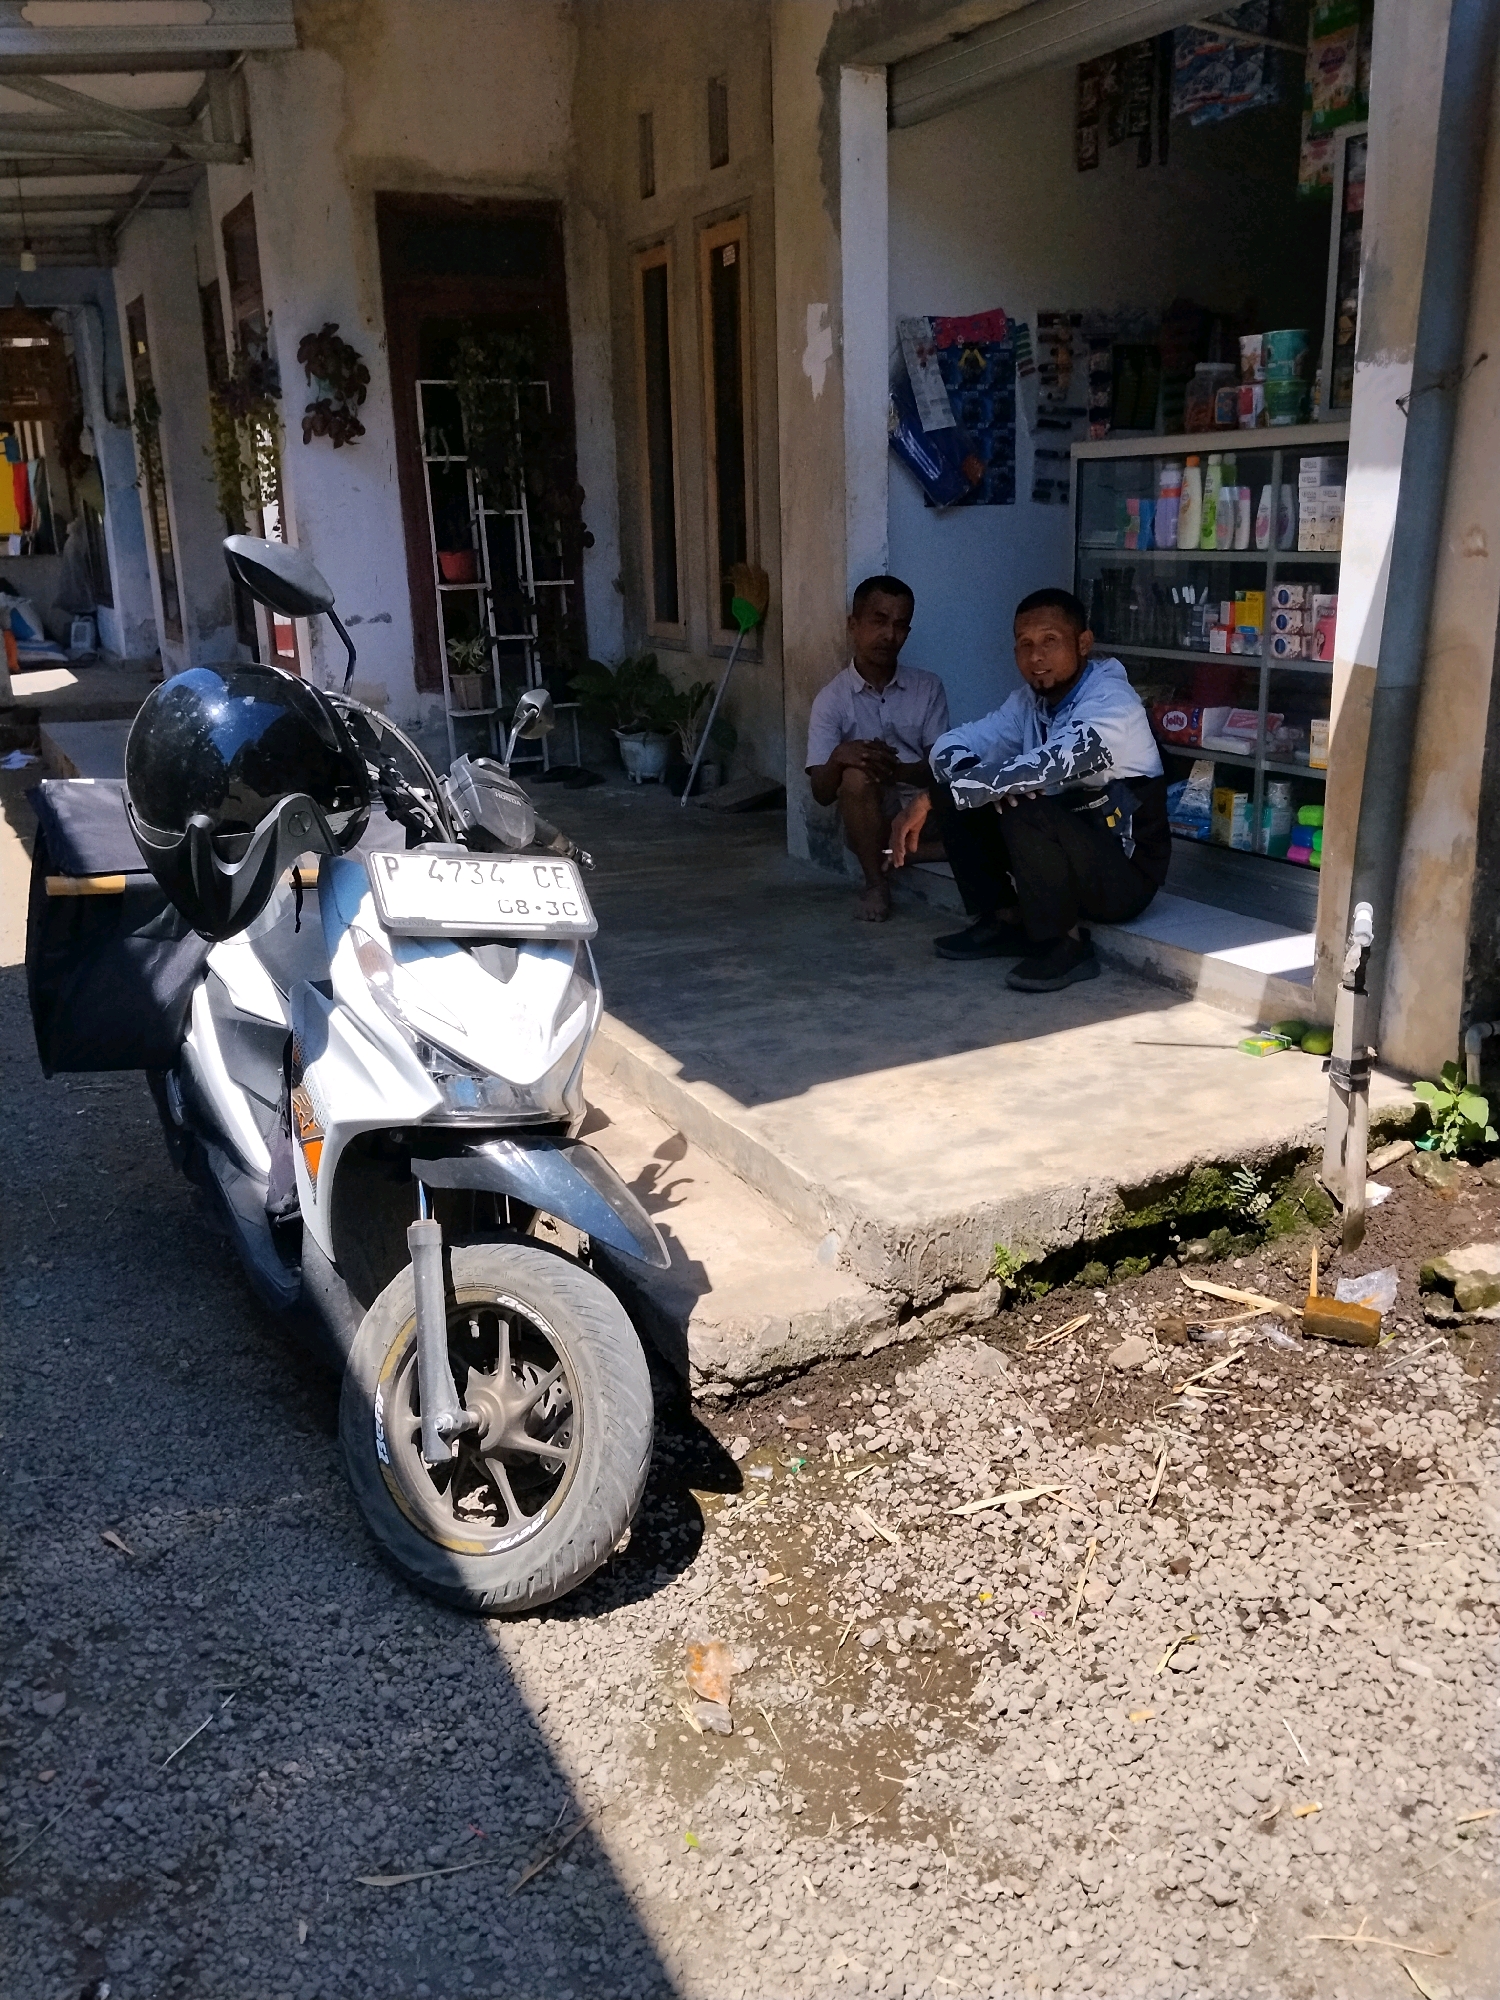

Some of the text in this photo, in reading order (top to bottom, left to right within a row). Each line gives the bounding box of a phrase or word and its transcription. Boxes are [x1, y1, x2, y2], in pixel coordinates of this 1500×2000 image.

[382, 855, 571, 890] P 4734 CE
